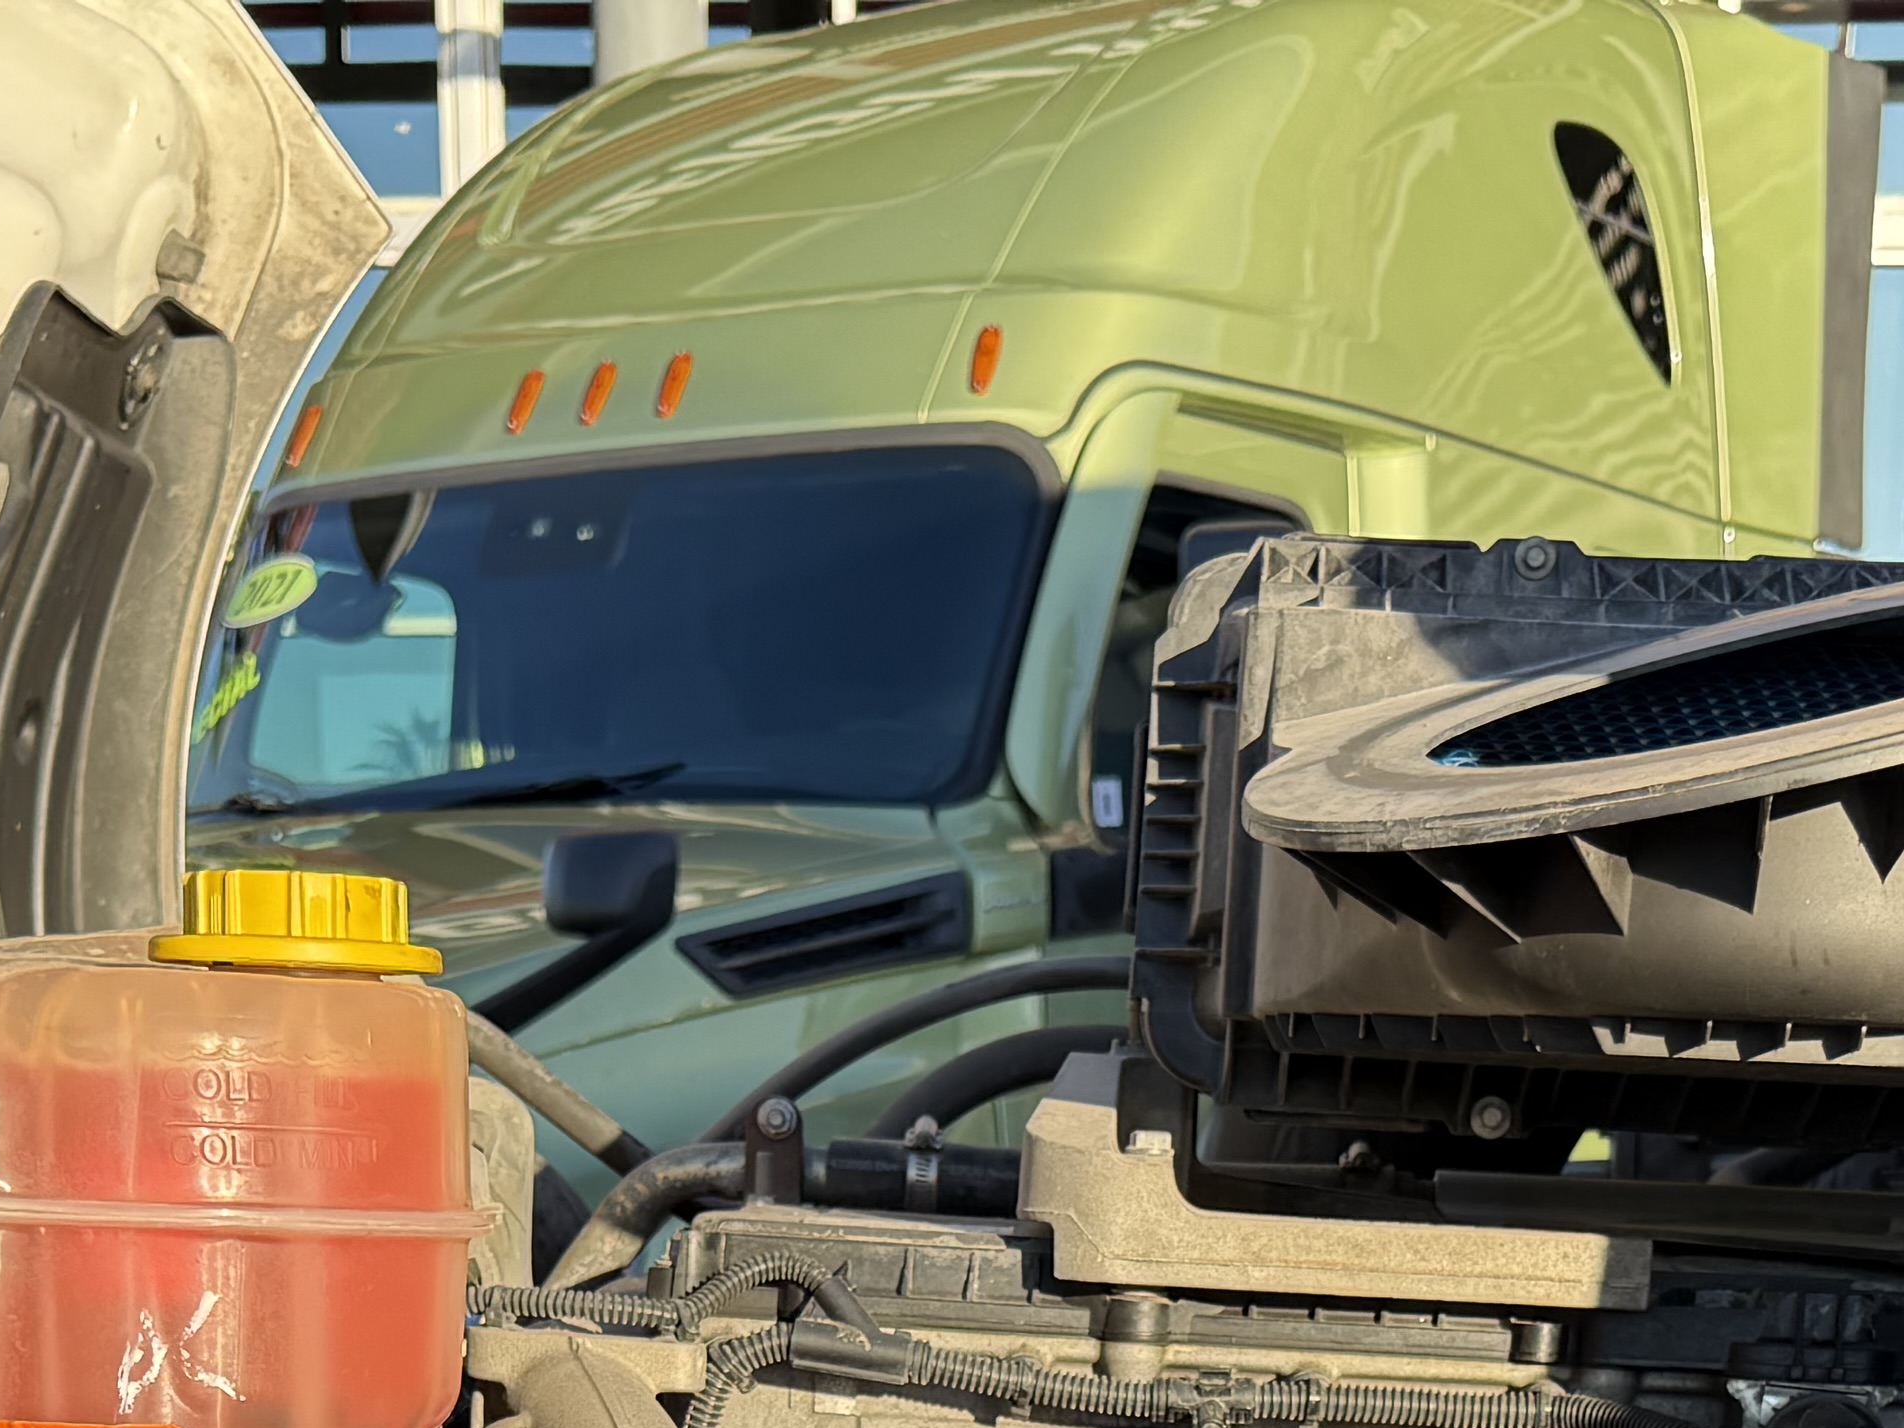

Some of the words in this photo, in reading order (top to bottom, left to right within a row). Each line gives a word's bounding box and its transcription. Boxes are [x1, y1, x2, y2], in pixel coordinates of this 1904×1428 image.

[235, 569, 303, 617] 2021
[163, 1068, 273, 1101] COLD
[169, 1134, 277, 1168] COLD
